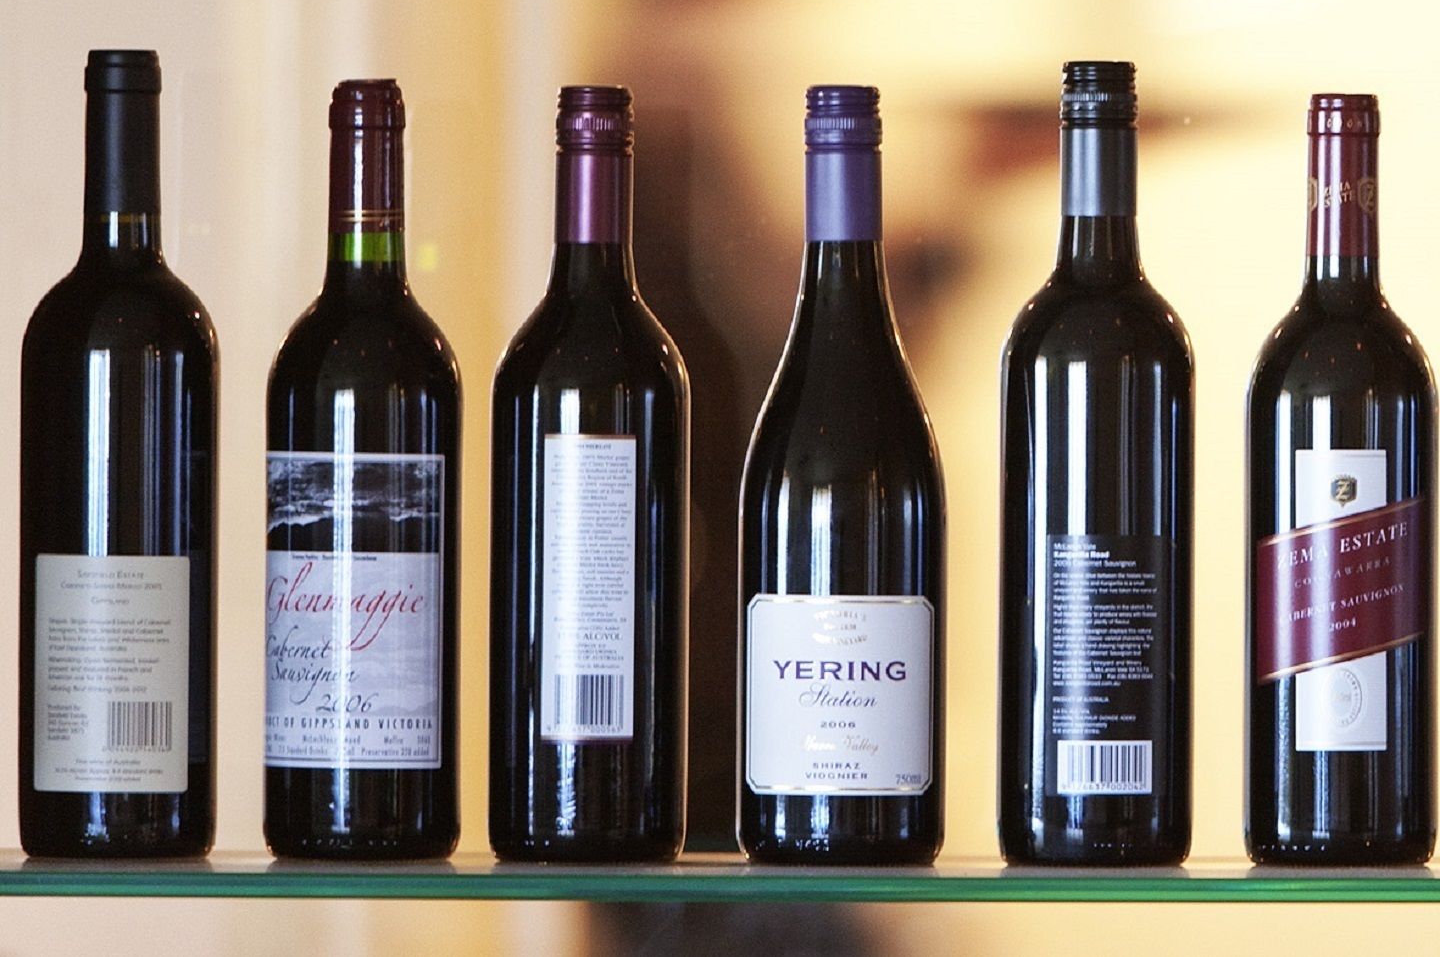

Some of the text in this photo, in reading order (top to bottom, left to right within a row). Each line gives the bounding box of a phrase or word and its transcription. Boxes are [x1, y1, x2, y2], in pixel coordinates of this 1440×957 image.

[1277, 521, 1410, 570] ZEMA ESTATE
[1280, 584, 1405, 624] ABERNT SAUVIGNON
[1328, 617, 1357, 632] 2004
[267, 626, 332, 660] Cabernet
[773, 660, 907, 681] YERING
[315, 693, 379, 713] 2006
[798, 683, 878, 708] Station
[284, 717, 433, 730] OF GIPPSAND VICTORIA
[805, 772, 868, 780] VIOGNIER
